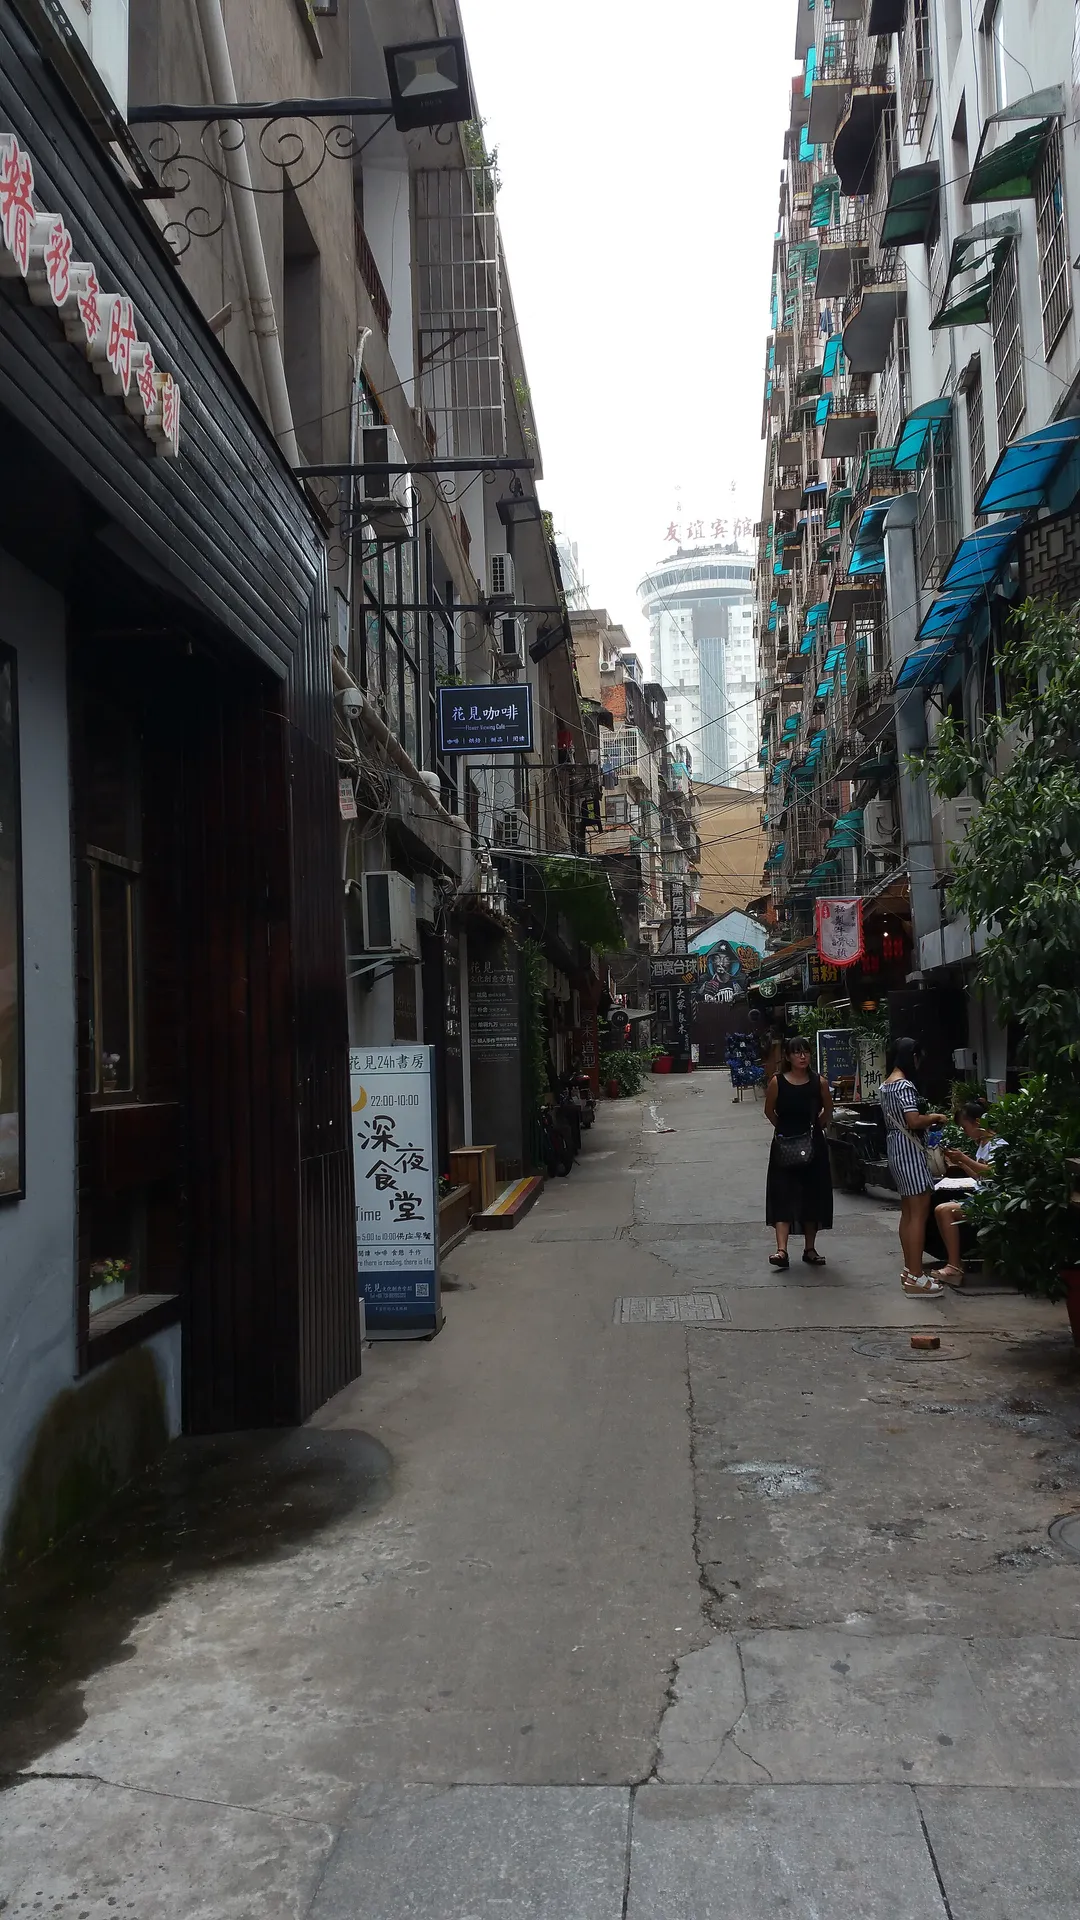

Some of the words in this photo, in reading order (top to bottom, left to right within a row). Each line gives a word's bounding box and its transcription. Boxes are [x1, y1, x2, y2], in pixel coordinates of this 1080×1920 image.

[452, 704, 519, 721] 花見咖啡
[650, 959, 698, 976] 酒窝台球
[370, 1094, 419, 1107] 22:00-10:00
